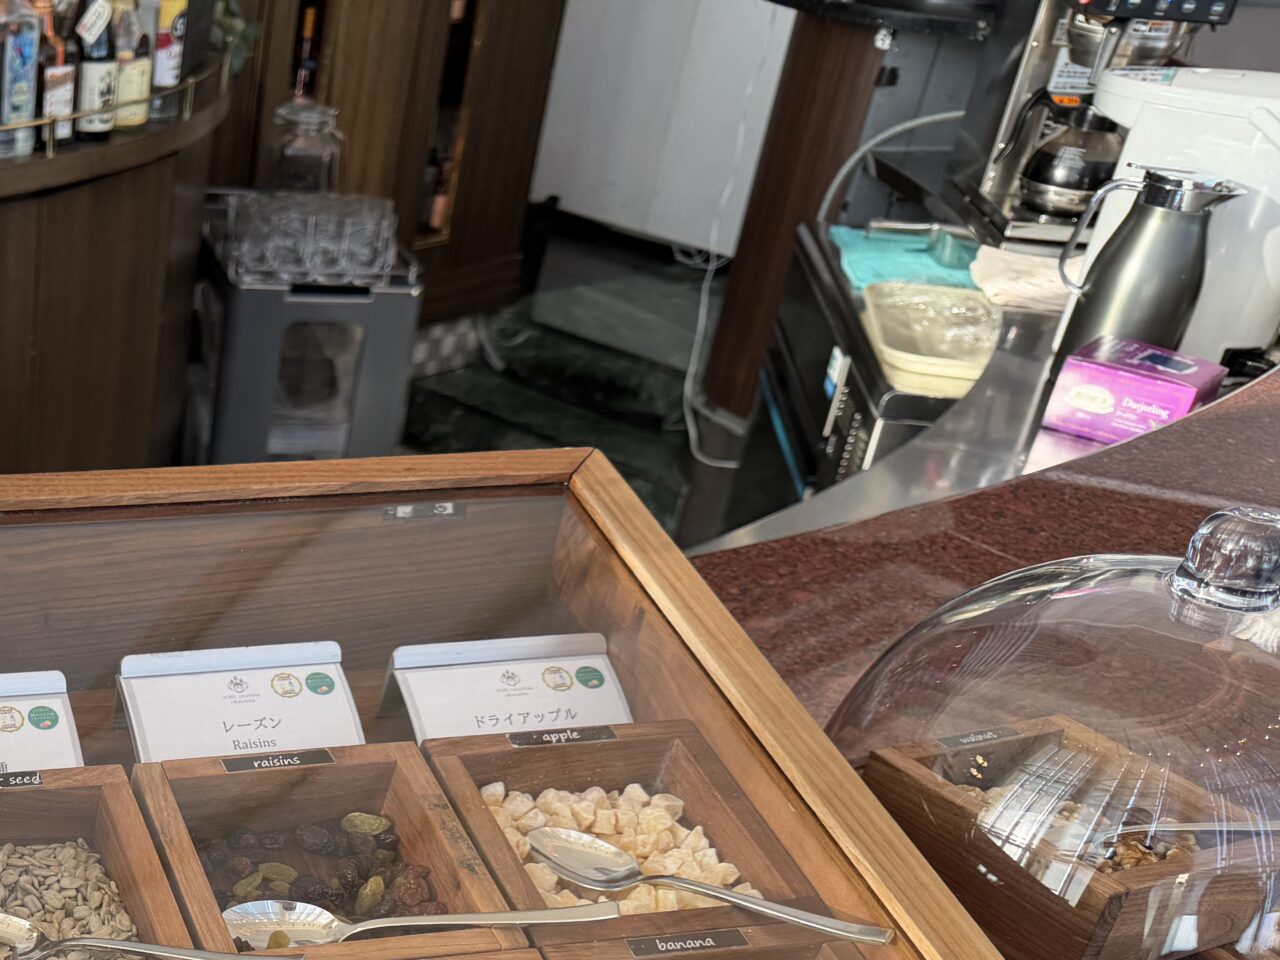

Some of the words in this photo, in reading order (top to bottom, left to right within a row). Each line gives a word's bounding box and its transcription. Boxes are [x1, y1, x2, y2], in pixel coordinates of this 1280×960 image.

[223, 716, 282, 733] レーズン
[474, 708, 577, 729] ドライアップル
[542, 729, 581, 743] apple
[232, 738, 277, 752] Raisins
[253, 756, 300, 769] raisins
[10, 771, 42, 786] seed
[655, 934, 716, 952] banana
